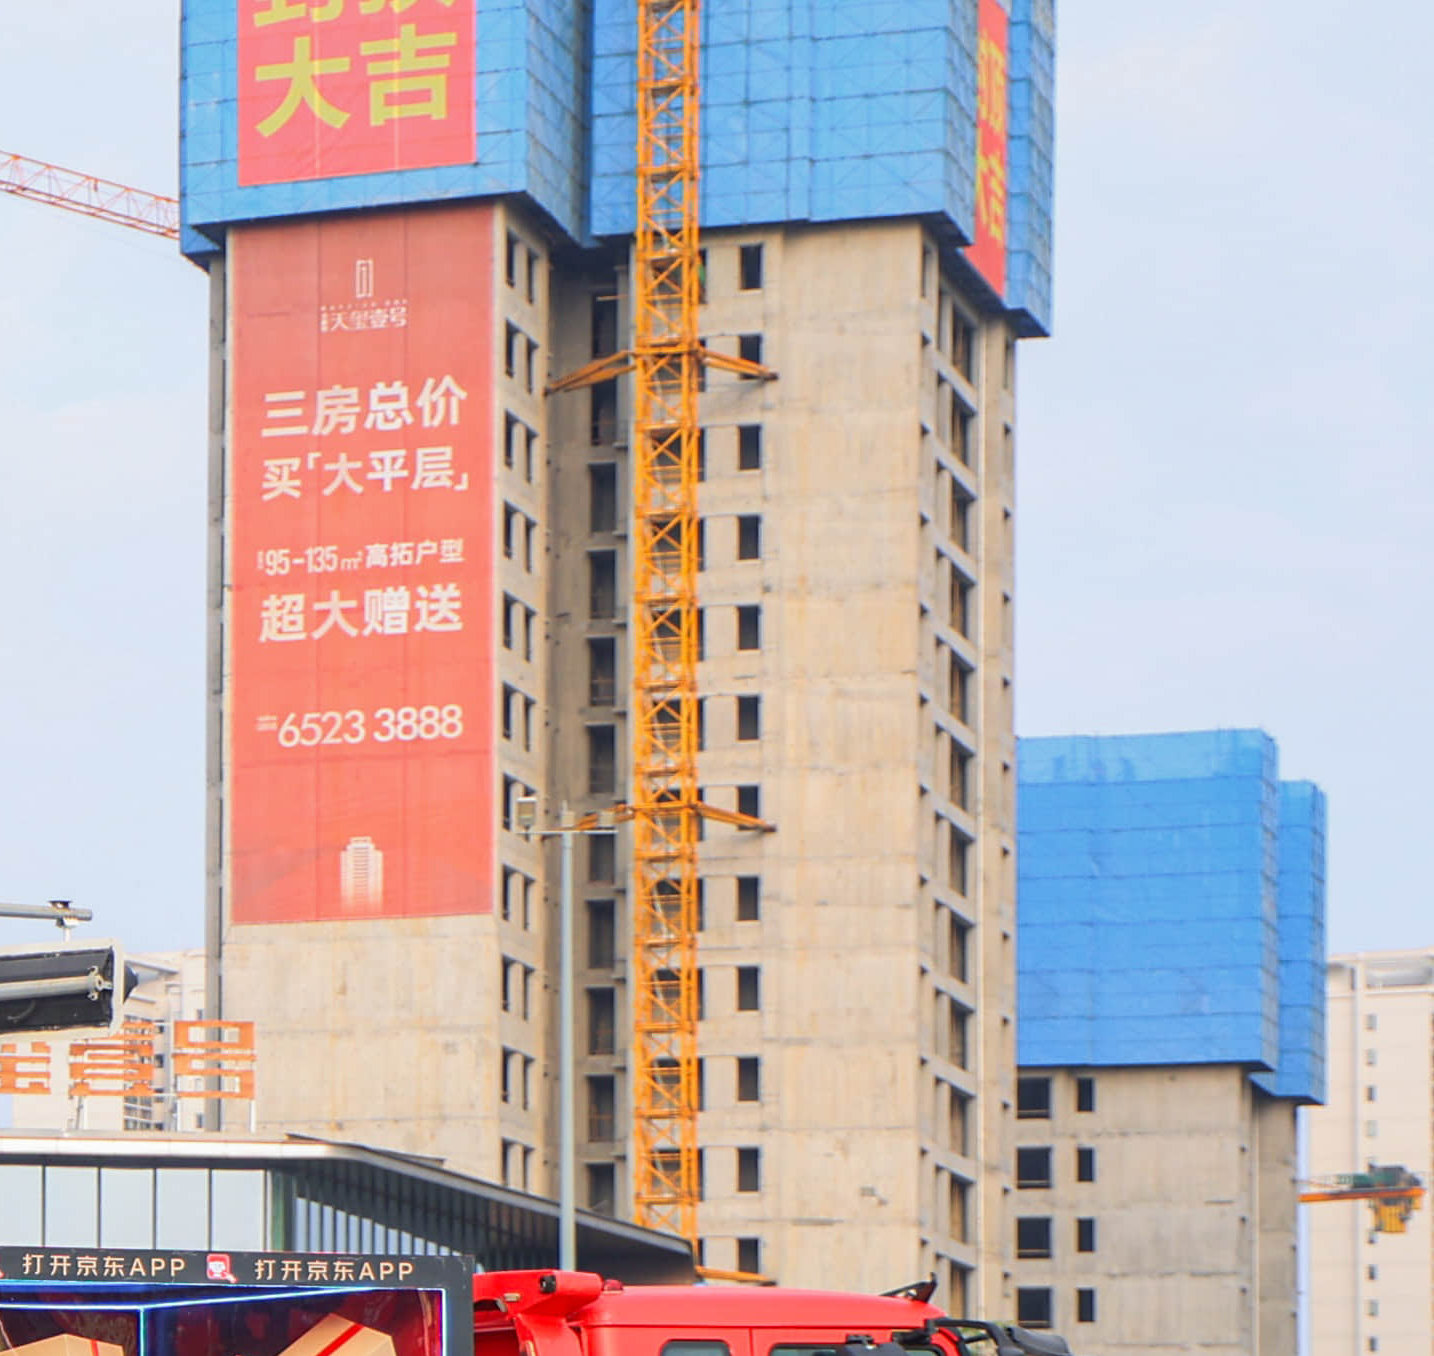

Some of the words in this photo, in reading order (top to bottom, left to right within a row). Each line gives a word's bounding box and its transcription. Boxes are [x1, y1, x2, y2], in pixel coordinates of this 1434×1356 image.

[255, 24, 457, 138] 大吉
[261, 374, 468, 438] 三房总价
[259, 582, 464, 643] 超大赠送
[278, 709, 366, 748] 6523
[373, 704, 464, 742] 3888
[23, 1253, 186, 1278] 打开京东APP
[255, 1259, 413, 1282] 打开京东APP
